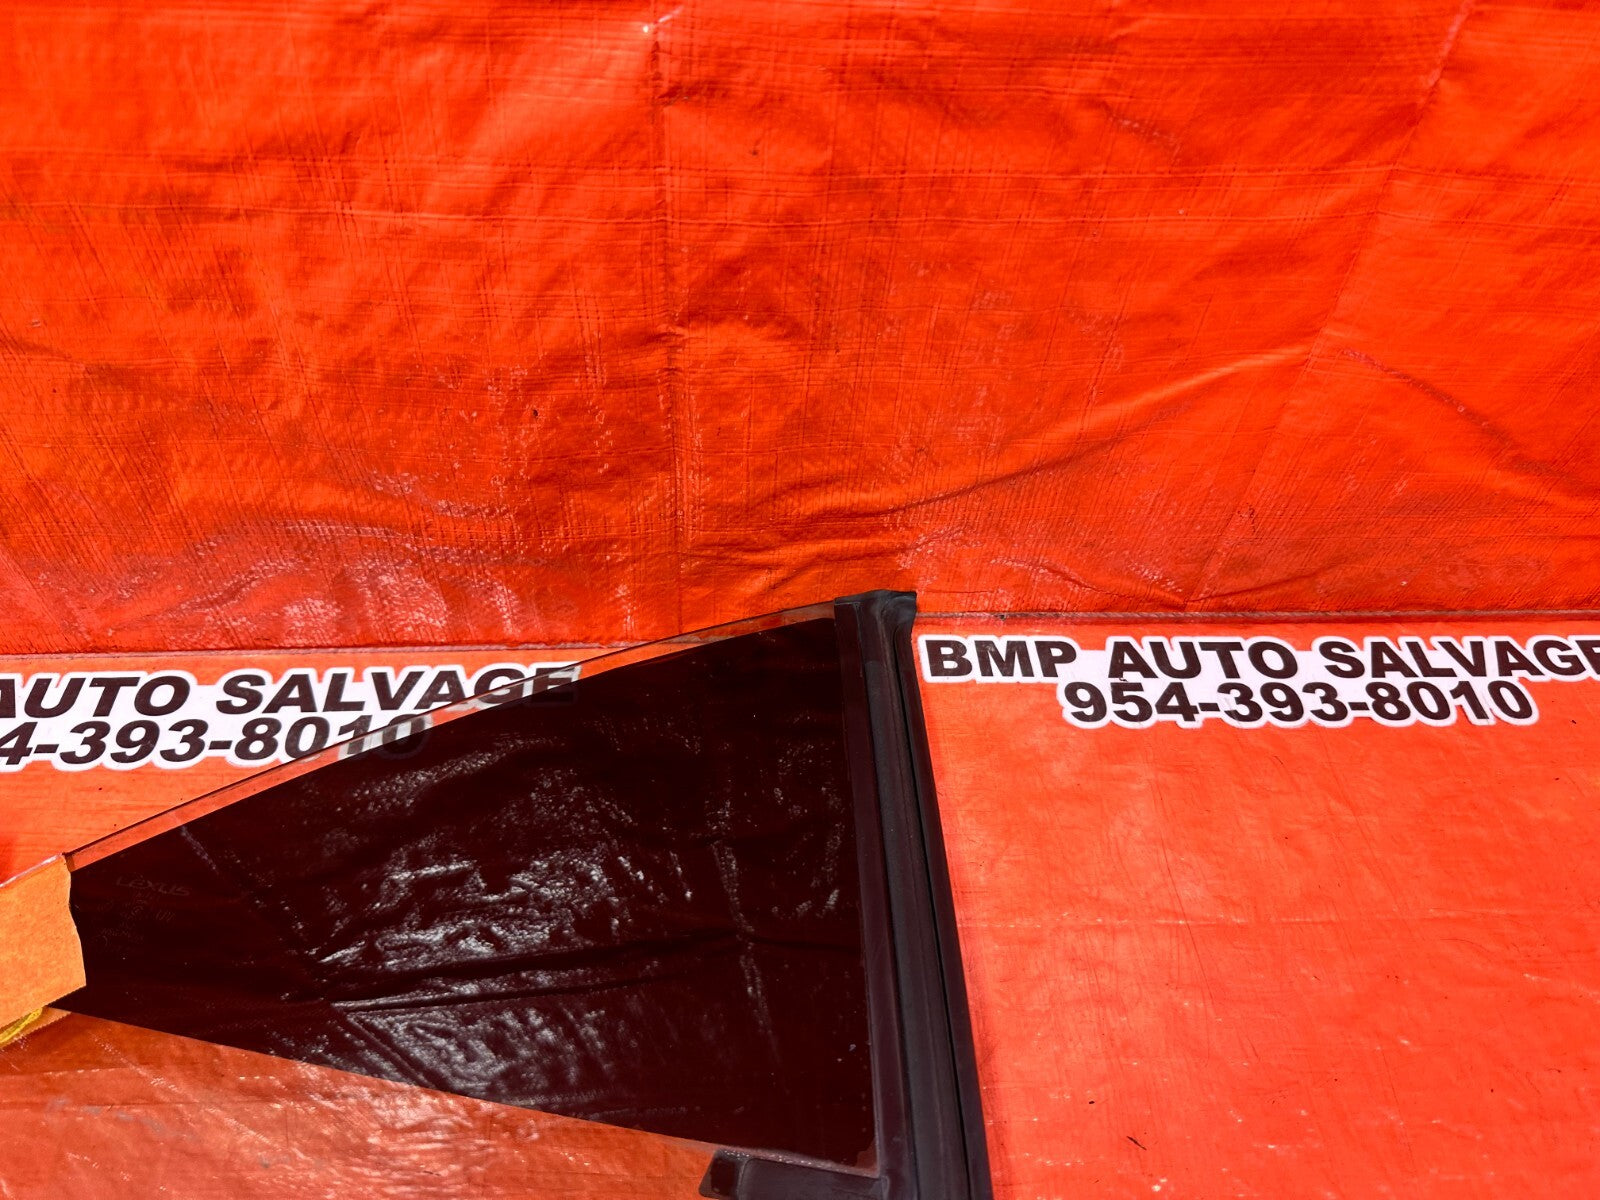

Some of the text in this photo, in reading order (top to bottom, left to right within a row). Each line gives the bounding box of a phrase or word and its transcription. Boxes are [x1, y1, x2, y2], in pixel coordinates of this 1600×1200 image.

[926, 639, 1077, 678] BMP
[1107, 640, 1299, 680] AUTO
[216, 665, 576, 715] SALVAGE
[1064, 680, 1534, 723] 954-393-8010
